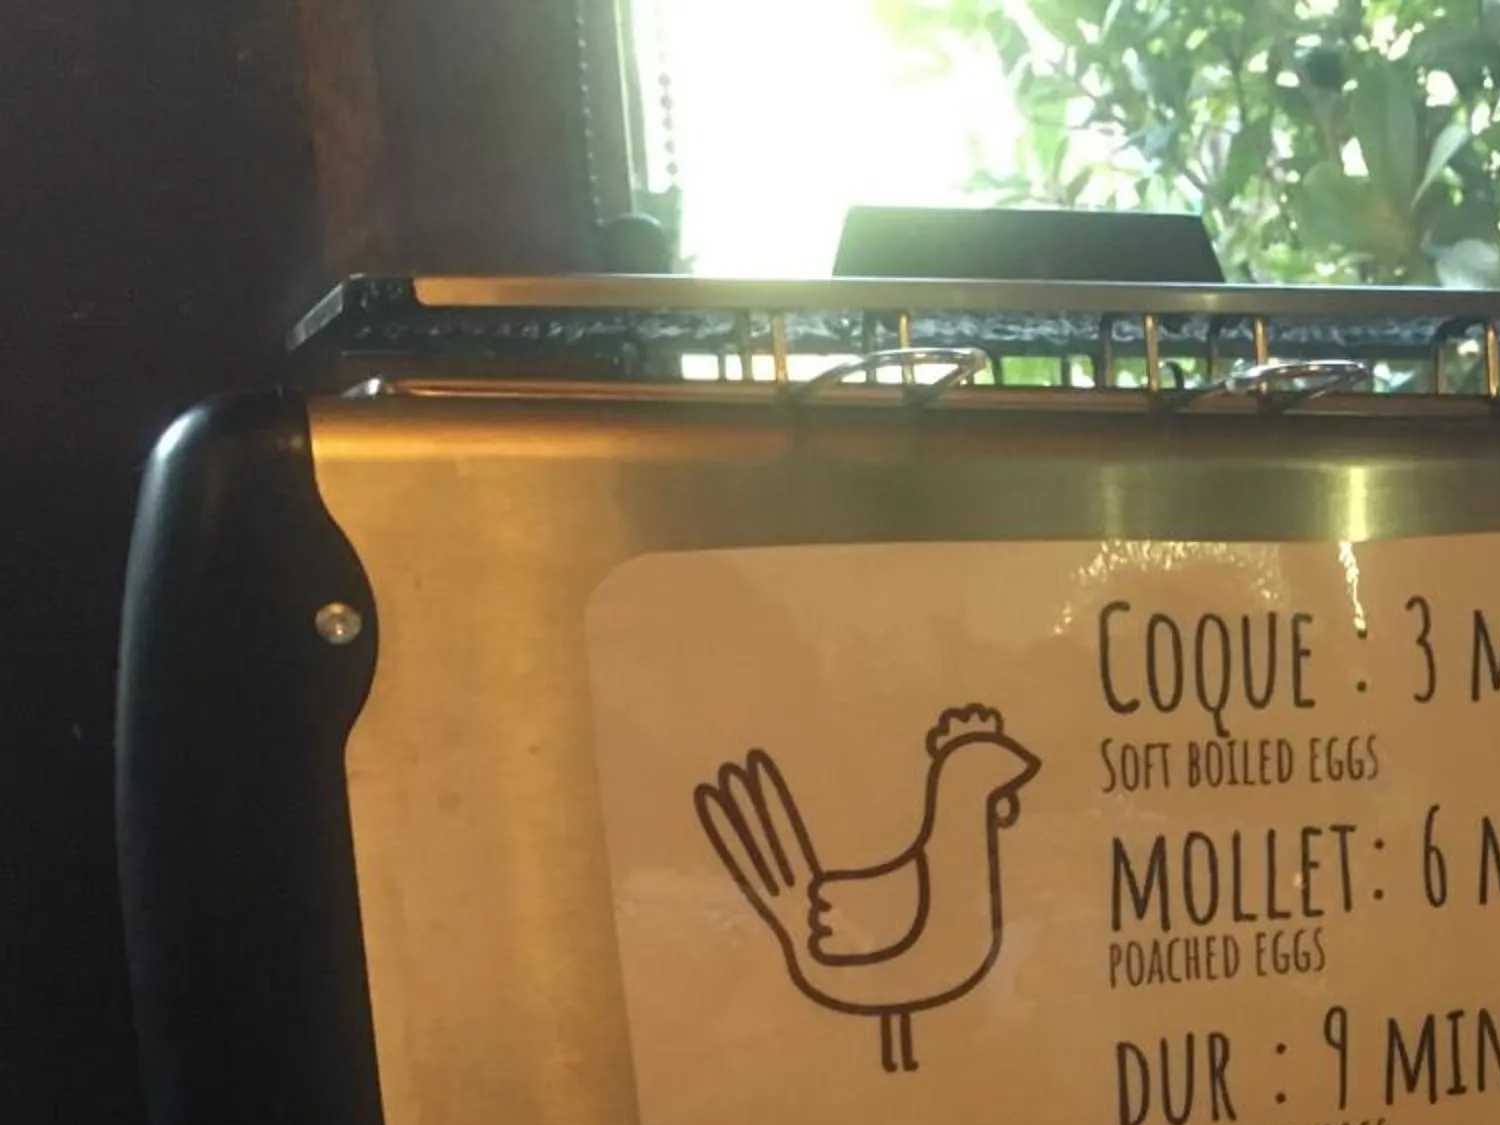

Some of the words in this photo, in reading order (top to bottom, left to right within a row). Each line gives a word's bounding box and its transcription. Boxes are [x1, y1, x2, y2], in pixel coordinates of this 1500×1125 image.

[1099, 600, 1317, 738] COQUE
[1405, 596, 1437, 703] 3
[1100, 738, 1172, 793] SOFT
[1187, 737, 1294, 788] BOILED
[1308, 734, 1381, 782] EGGS
[1423, 804, 1448, 908] 6
[1109, 934, 1240, 989] POACHED
[1255, 926, 1327, 978] EGGS
[1322, 1005, 1348, 1111] 9
